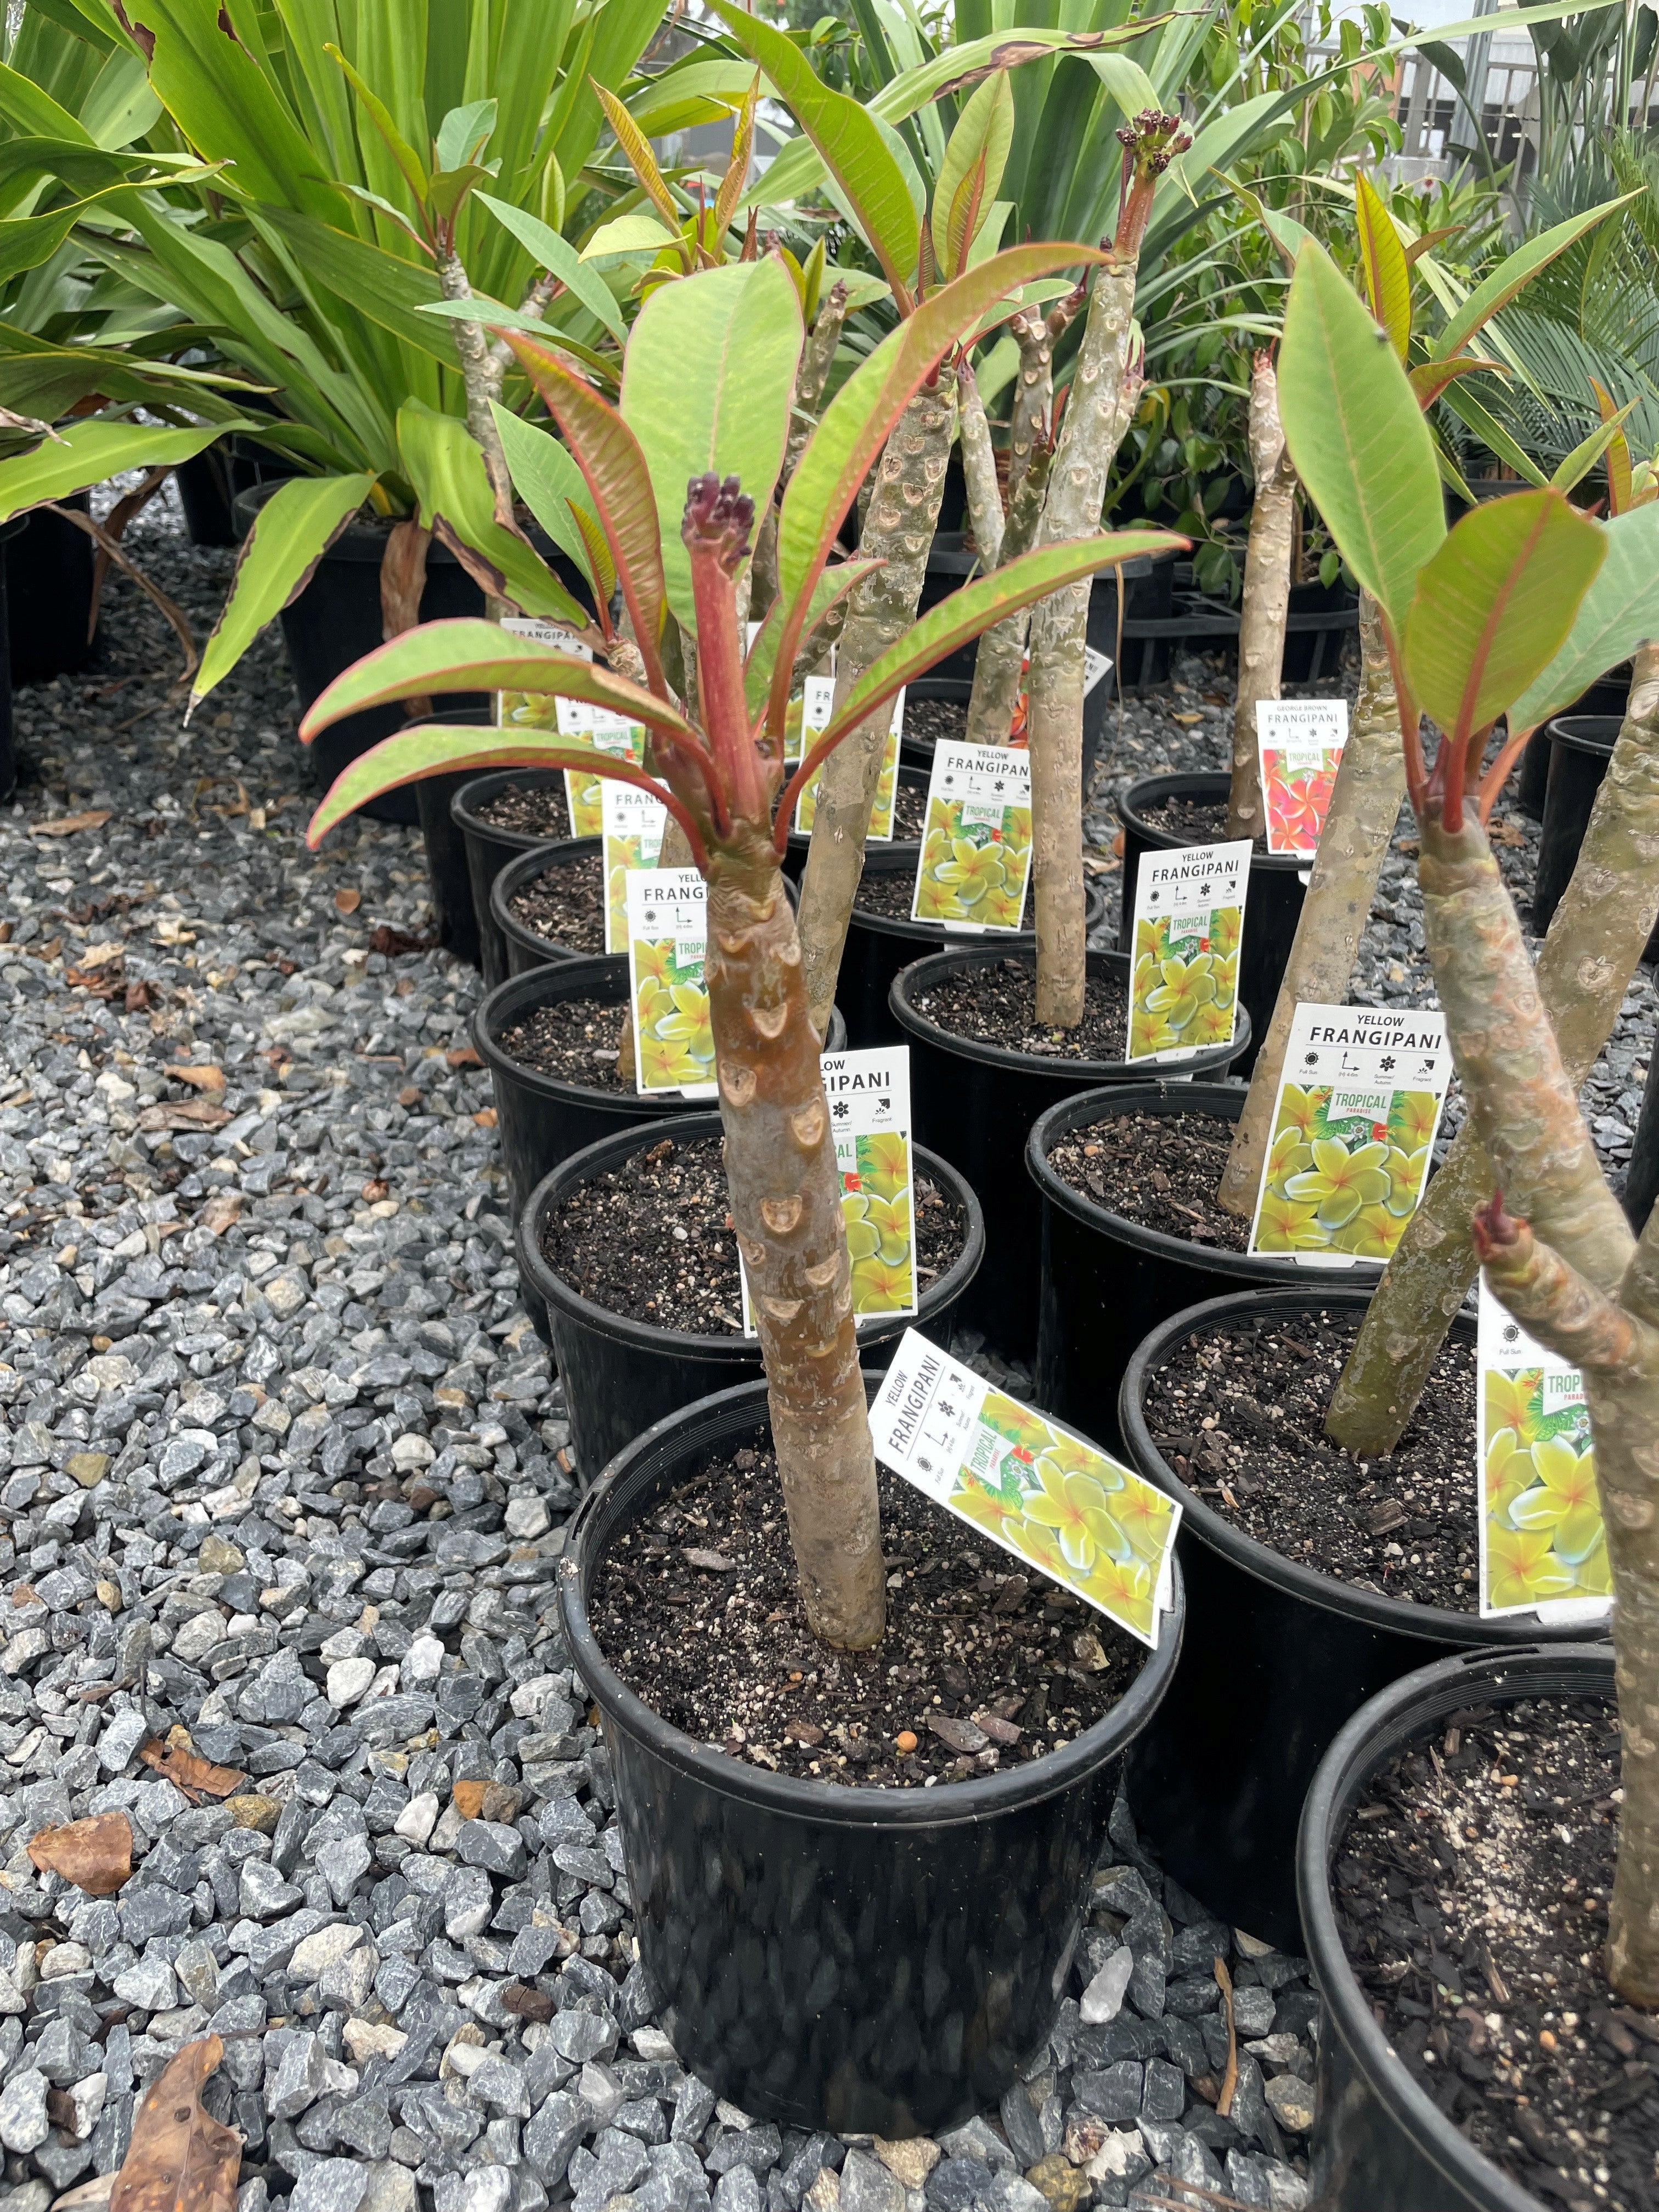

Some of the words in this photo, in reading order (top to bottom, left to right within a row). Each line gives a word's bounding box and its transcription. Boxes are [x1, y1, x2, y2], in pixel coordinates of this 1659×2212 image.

[512, 630, 575, 640] RANGIPA
[1267, 714, 1338, 723] FRANGIPANI
[977, 750, 1009, 760] YELLOW
[1289, 752, 1321, 761] TROPICAL
[966, 805, 1000, 819] TROPICAL
[1182, 851, 1214, 862] YELLOW
[1152, 860, 1239, 882] FRANGIPANI
[1173, 915, 1207, 930] TROPICAL
[679, 943, 706, 955] TROPI
[1357, 1015, 1404, 1026] YELLOW
[1310, 1026, 1442, 1049] FRANGIPANI
[1335, 1093, 1386, 1109] TROPICAL
[885, 1369, 909, 1407] YELLOW
[888, 1353, 941, 1455] FRANGIPANI
[970, 1429, 997, 1475] TROPICAL
